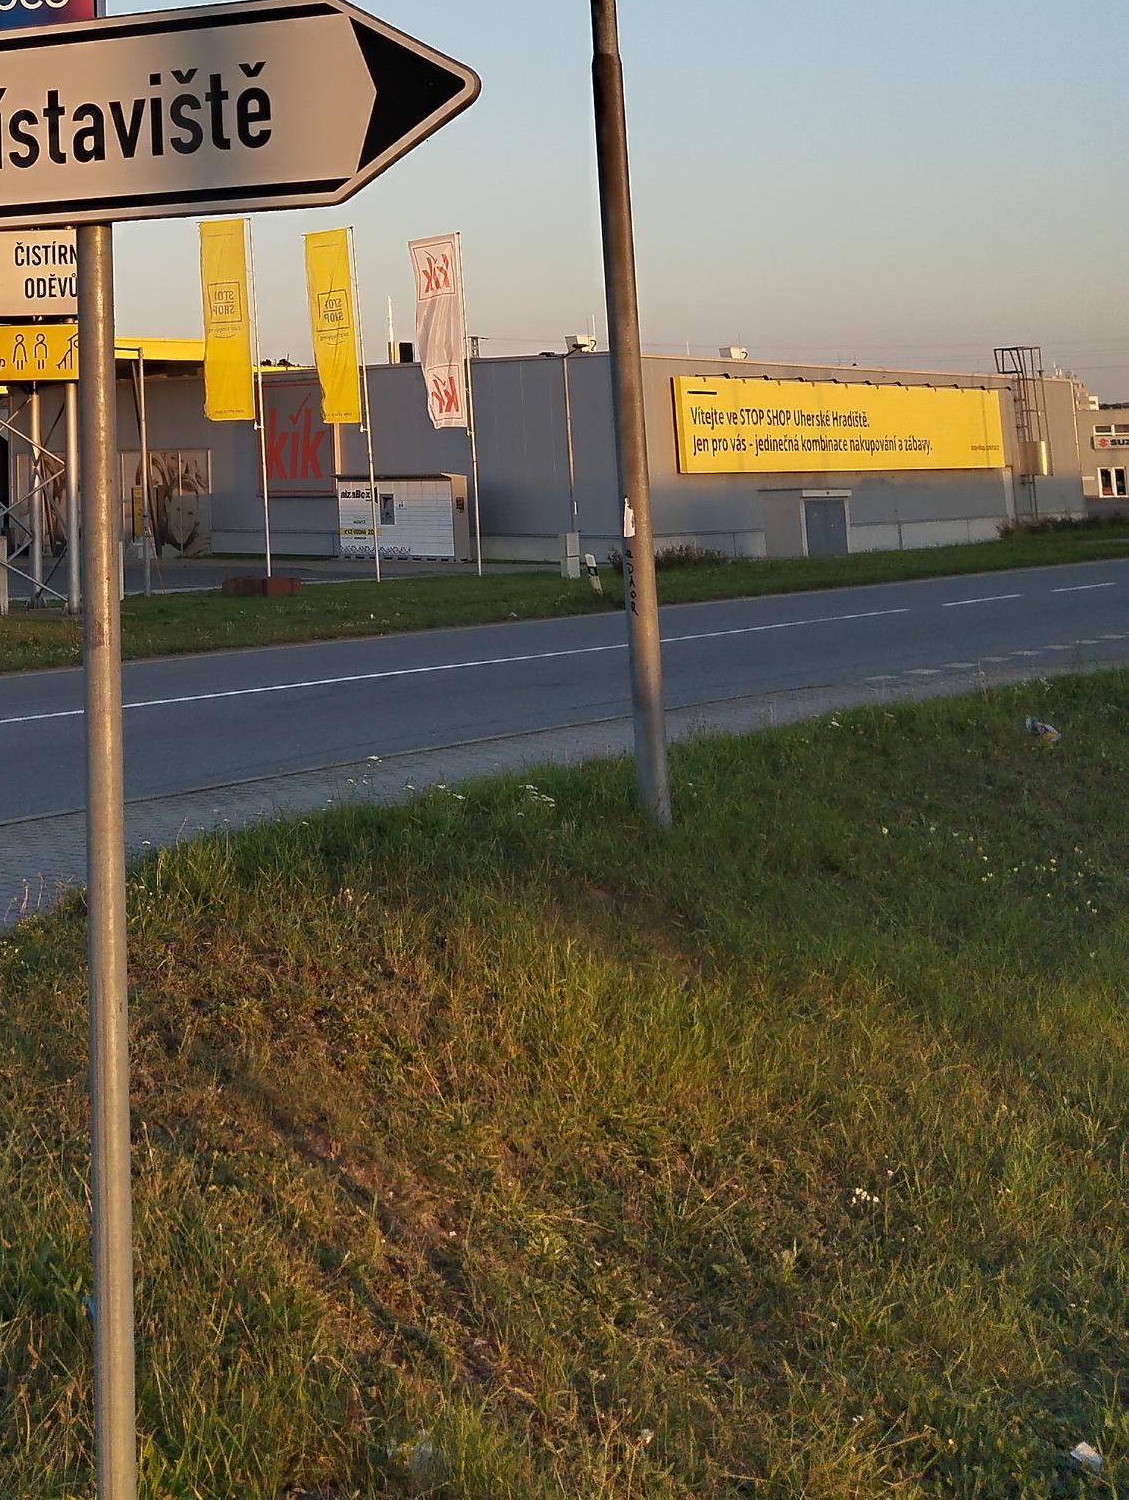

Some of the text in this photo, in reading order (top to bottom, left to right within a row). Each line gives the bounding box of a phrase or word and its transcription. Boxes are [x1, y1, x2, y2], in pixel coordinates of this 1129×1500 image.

[24, 272, 77, 299] ODĚVŮ
[690, 406, 870, 430] Vítejte ve STOP SHOP Uherské Hradiště.
[693, 435, 709, 456] Jen
[712, 438, 728, 456] pro
[731, 433, 747, 451] vás
[755, 434, 799, 456] jedinečná
[801, 434, 848, 451] kombinace
[850, 435, 896, 456] nakupování
[905, 435, 933, 455] zábavy.
